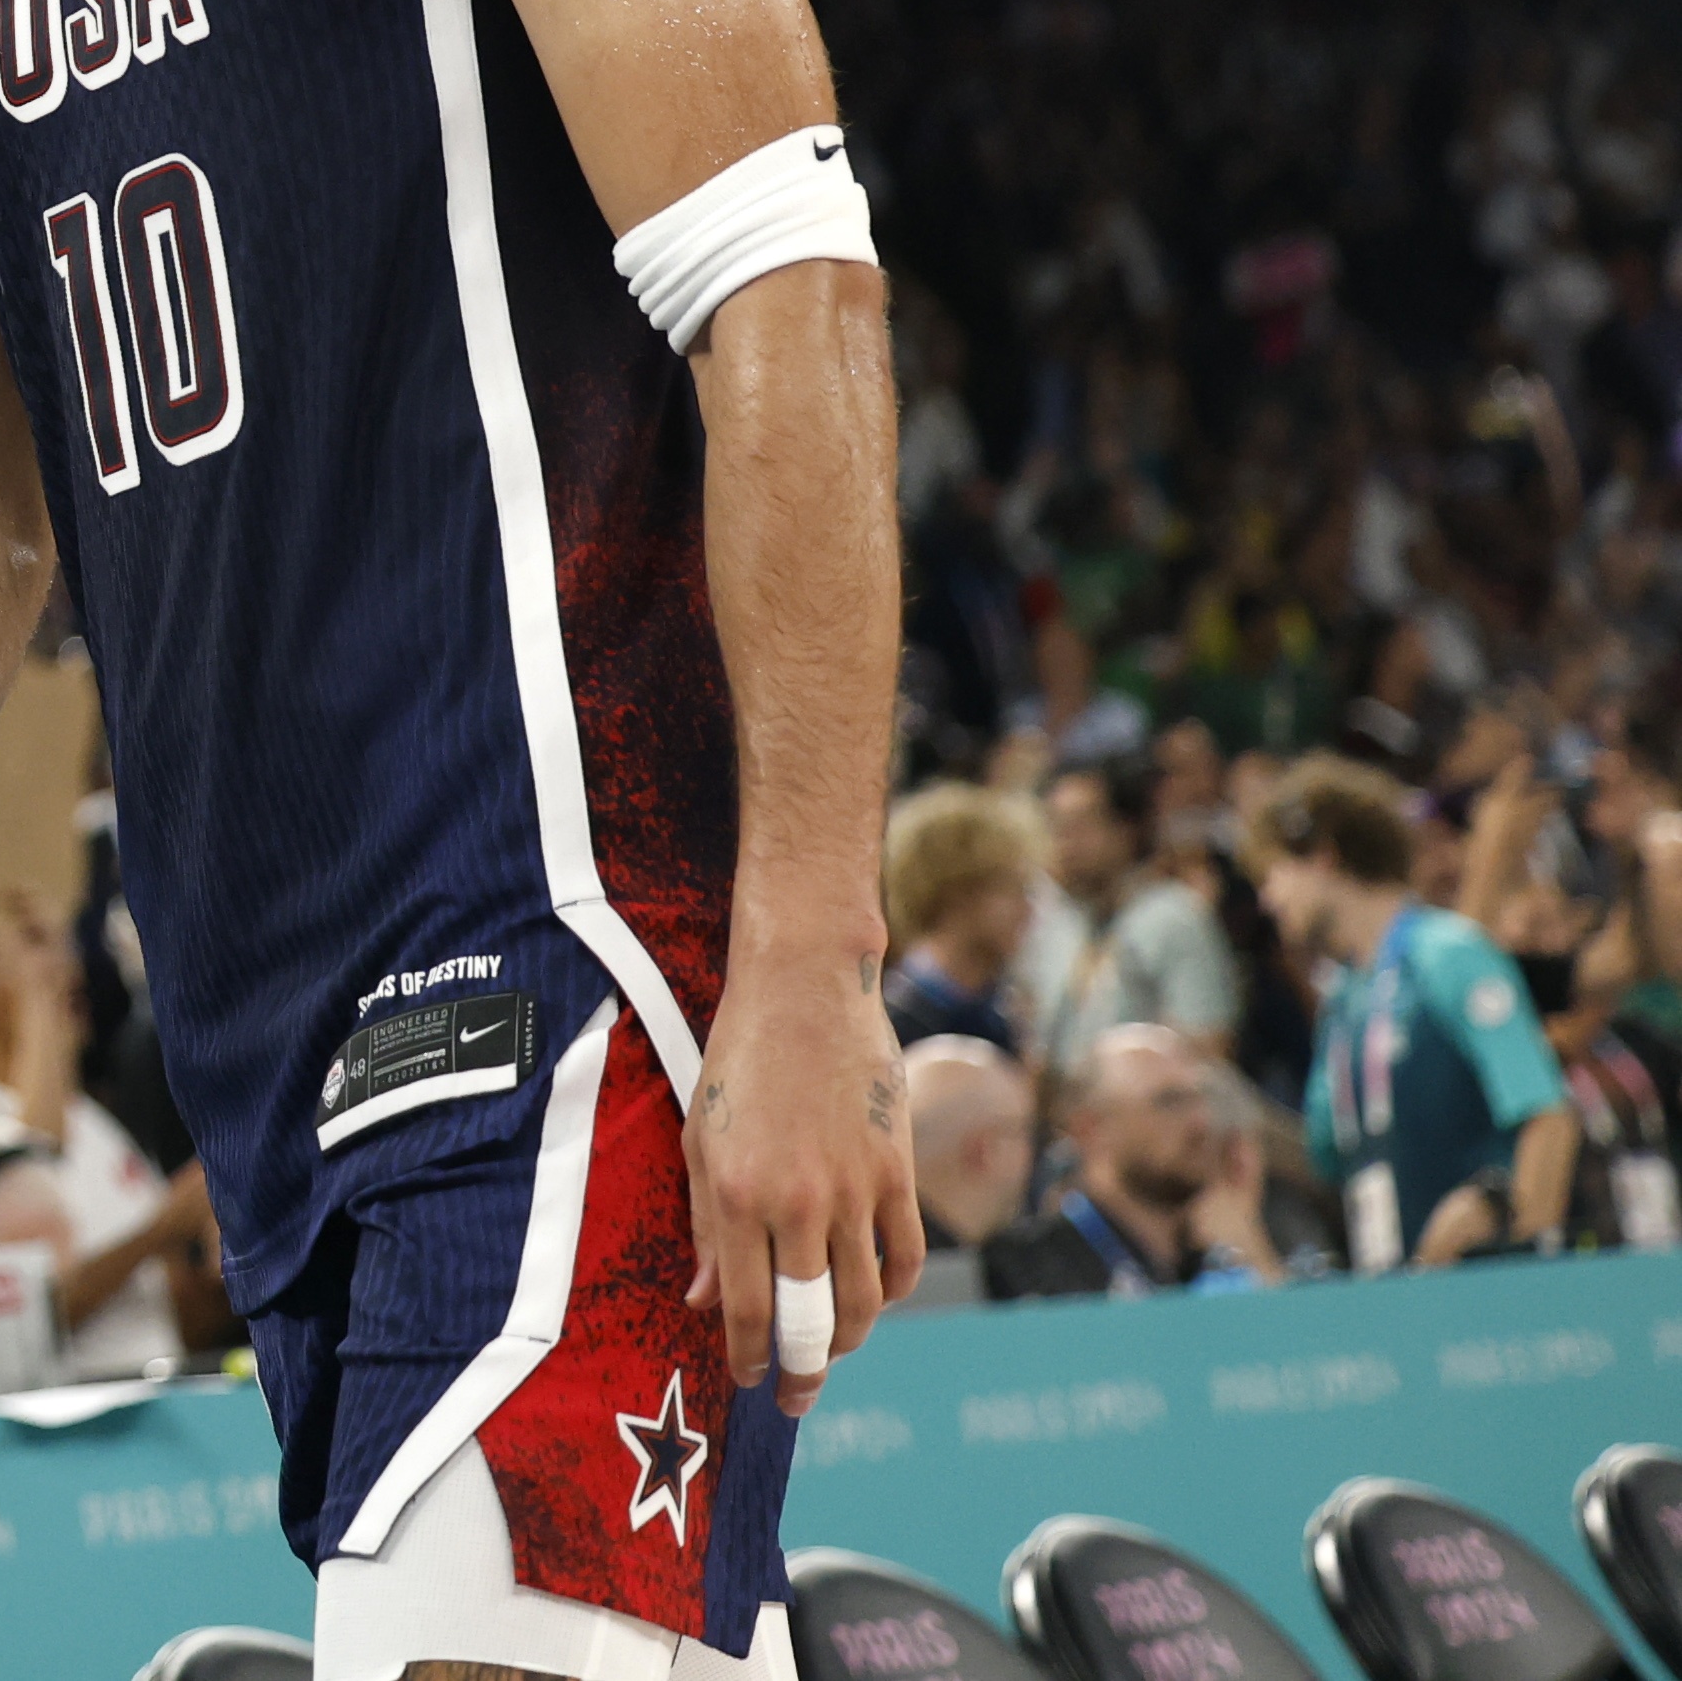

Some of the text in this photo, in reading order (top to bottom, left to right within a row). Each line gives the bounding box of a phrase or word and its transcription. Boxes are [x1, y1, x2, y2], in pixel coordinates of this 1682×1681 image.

[43, 153, 244, 496] 10
[400, 971, 426, 996] OF
[425, 955, 502, 988] DESTINY
[373, 1008, 448, 1040] ENGINEERED
[349, 1058, 366, 1079] 48
